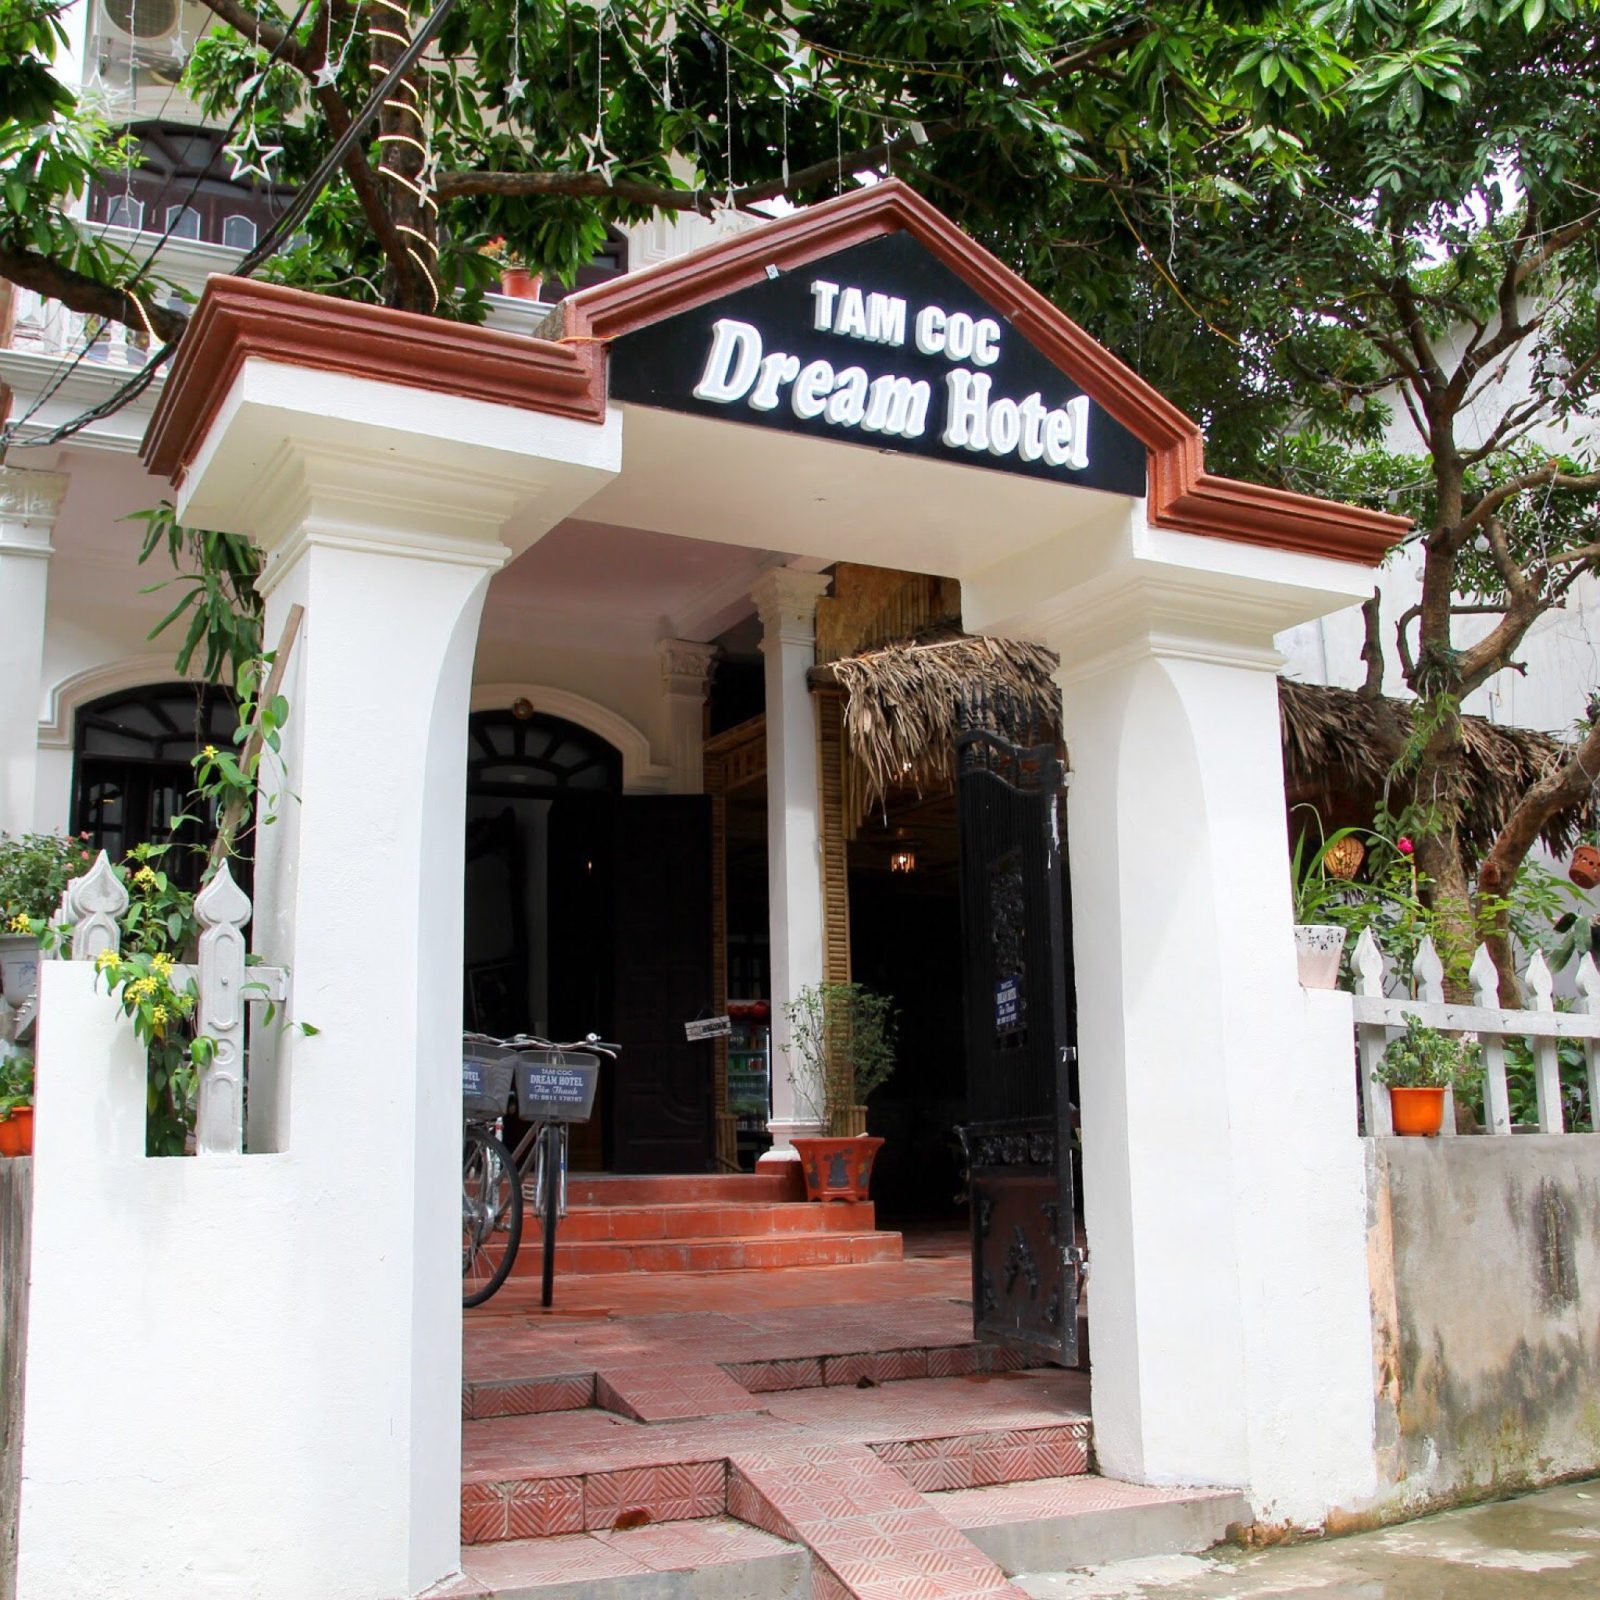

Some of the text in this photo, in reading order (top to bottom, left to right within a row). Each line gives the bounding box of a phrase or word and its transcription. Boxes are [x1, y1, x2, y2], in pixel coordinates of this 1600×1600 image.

[810, 279, 1001, 366] TAM COC
[693, 318, 1090, 470] Dream Hotel
[530, 1074, 584, 1087] DREAM HOTEL
